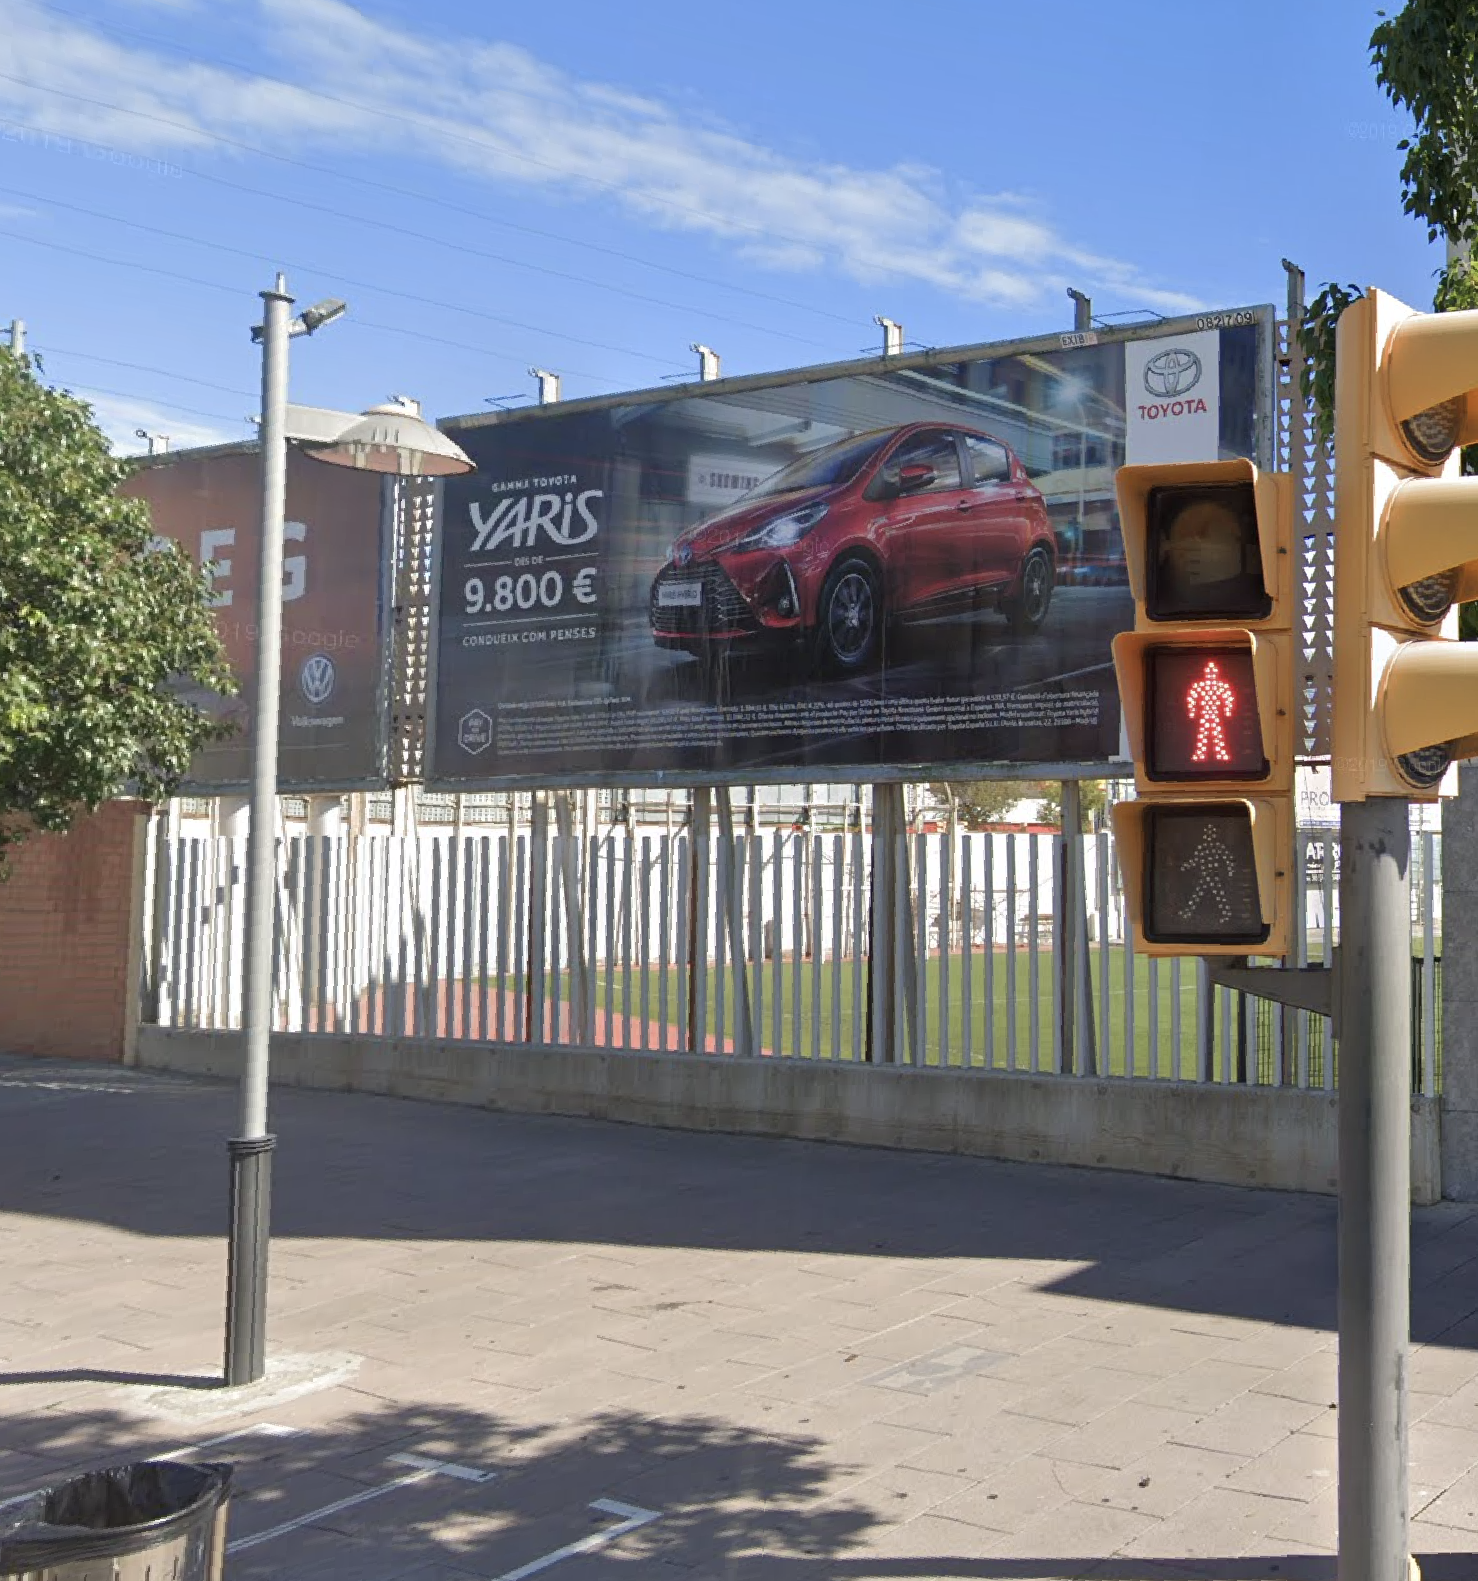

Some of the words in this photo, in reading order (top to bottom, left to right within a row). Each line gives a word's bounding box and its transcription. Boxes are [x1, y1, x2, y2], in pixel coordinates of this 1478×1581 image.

[1138, 398, 1207, 421] TOYOTA
[533, 474, 577, 488] TOYOTA
[464, 570, 564, 614] 9.800
[572, 567, 598, 604] €
[462, 632, 519, 647] CONDUEIX
[521, 630, 547, 643] COM
[550, 627, 597, 640] PENSES
